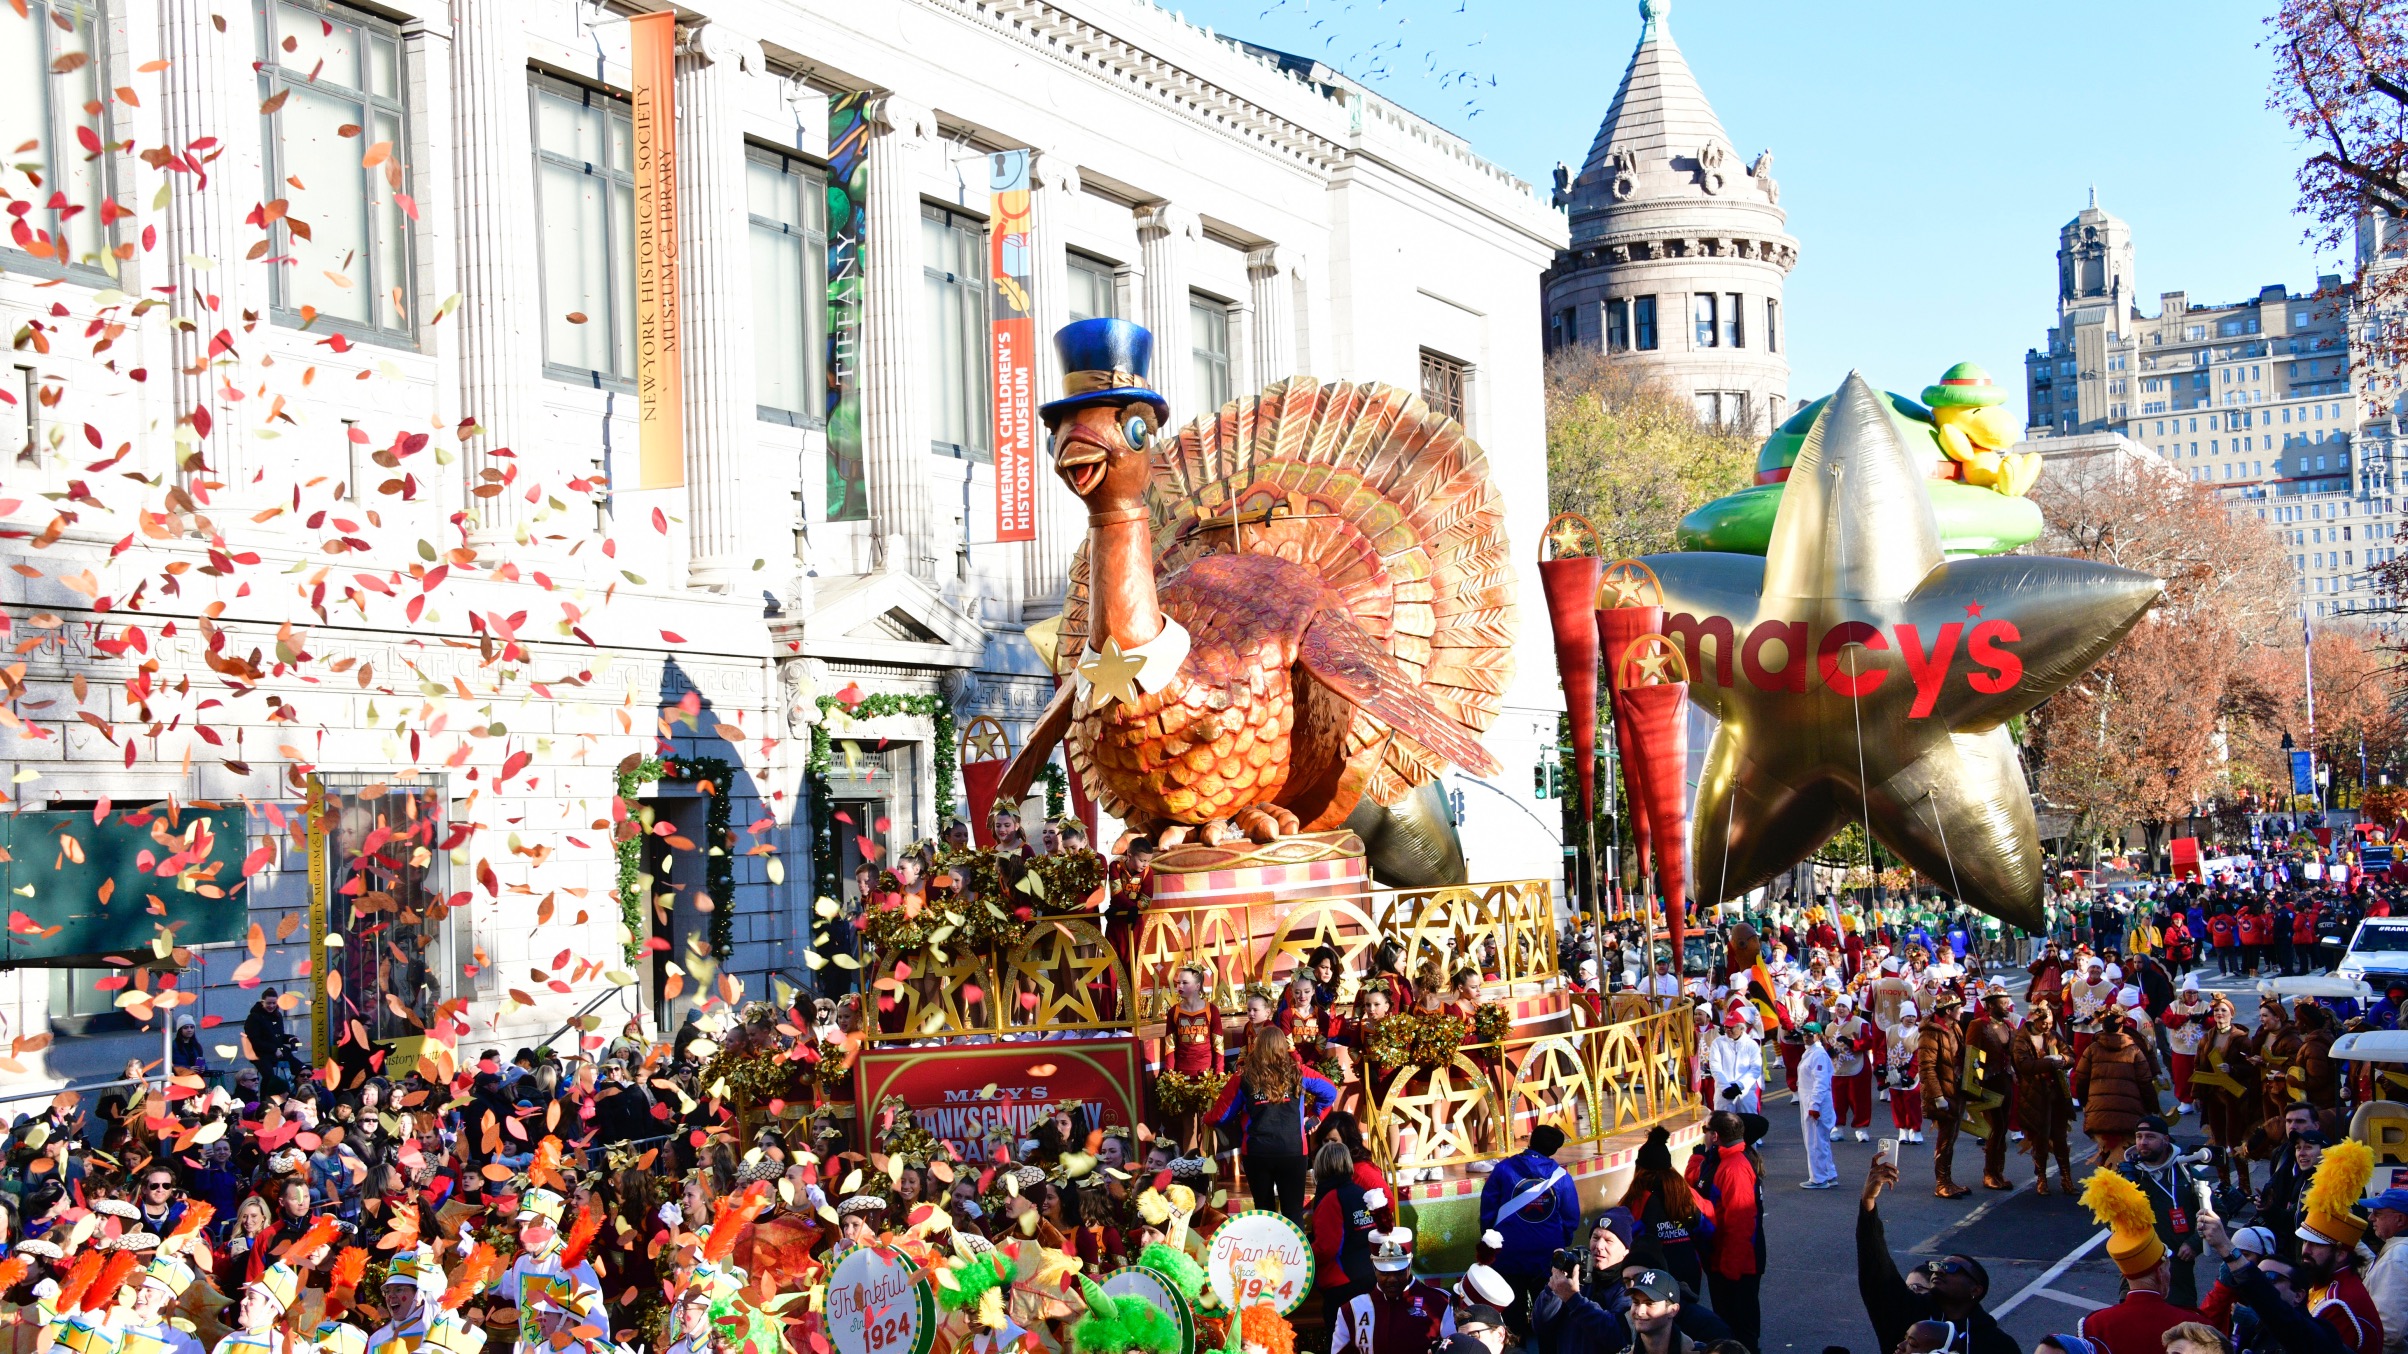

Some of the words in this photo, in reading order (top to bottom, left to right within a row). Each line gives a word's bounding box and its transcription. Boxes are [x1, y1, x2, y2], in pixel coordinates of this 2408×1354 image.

[637, 85, 651, 170] SOCIETY
[659, 149, 673, 233] LIBRARY
[640, 179, 654, 303] HISTORICAL
[658, 234, 677, 258] &
[661, 263, 676, 352] MUSEUM
[835, 231, 857, 385] TIFFANY
[642, 312, 656, 421] NEW-YORK
[998, 331, 1013, 438] CHILDREN'S
[1015, 367, 1029, 448] MUSEUM
[1000, 442, 1014, 530] DIMENNA
[1017, 455, 1030, 529] HISTORY
[317, 1018, 325, 1067] EW-YORK
[829, 1269, 906, 1319] Thnkful
[1234, 1264, 1256, 1277] Snce
[1240, 1278, 1294, 1300] 194
[863, 1311, 911, 1354] 1924
